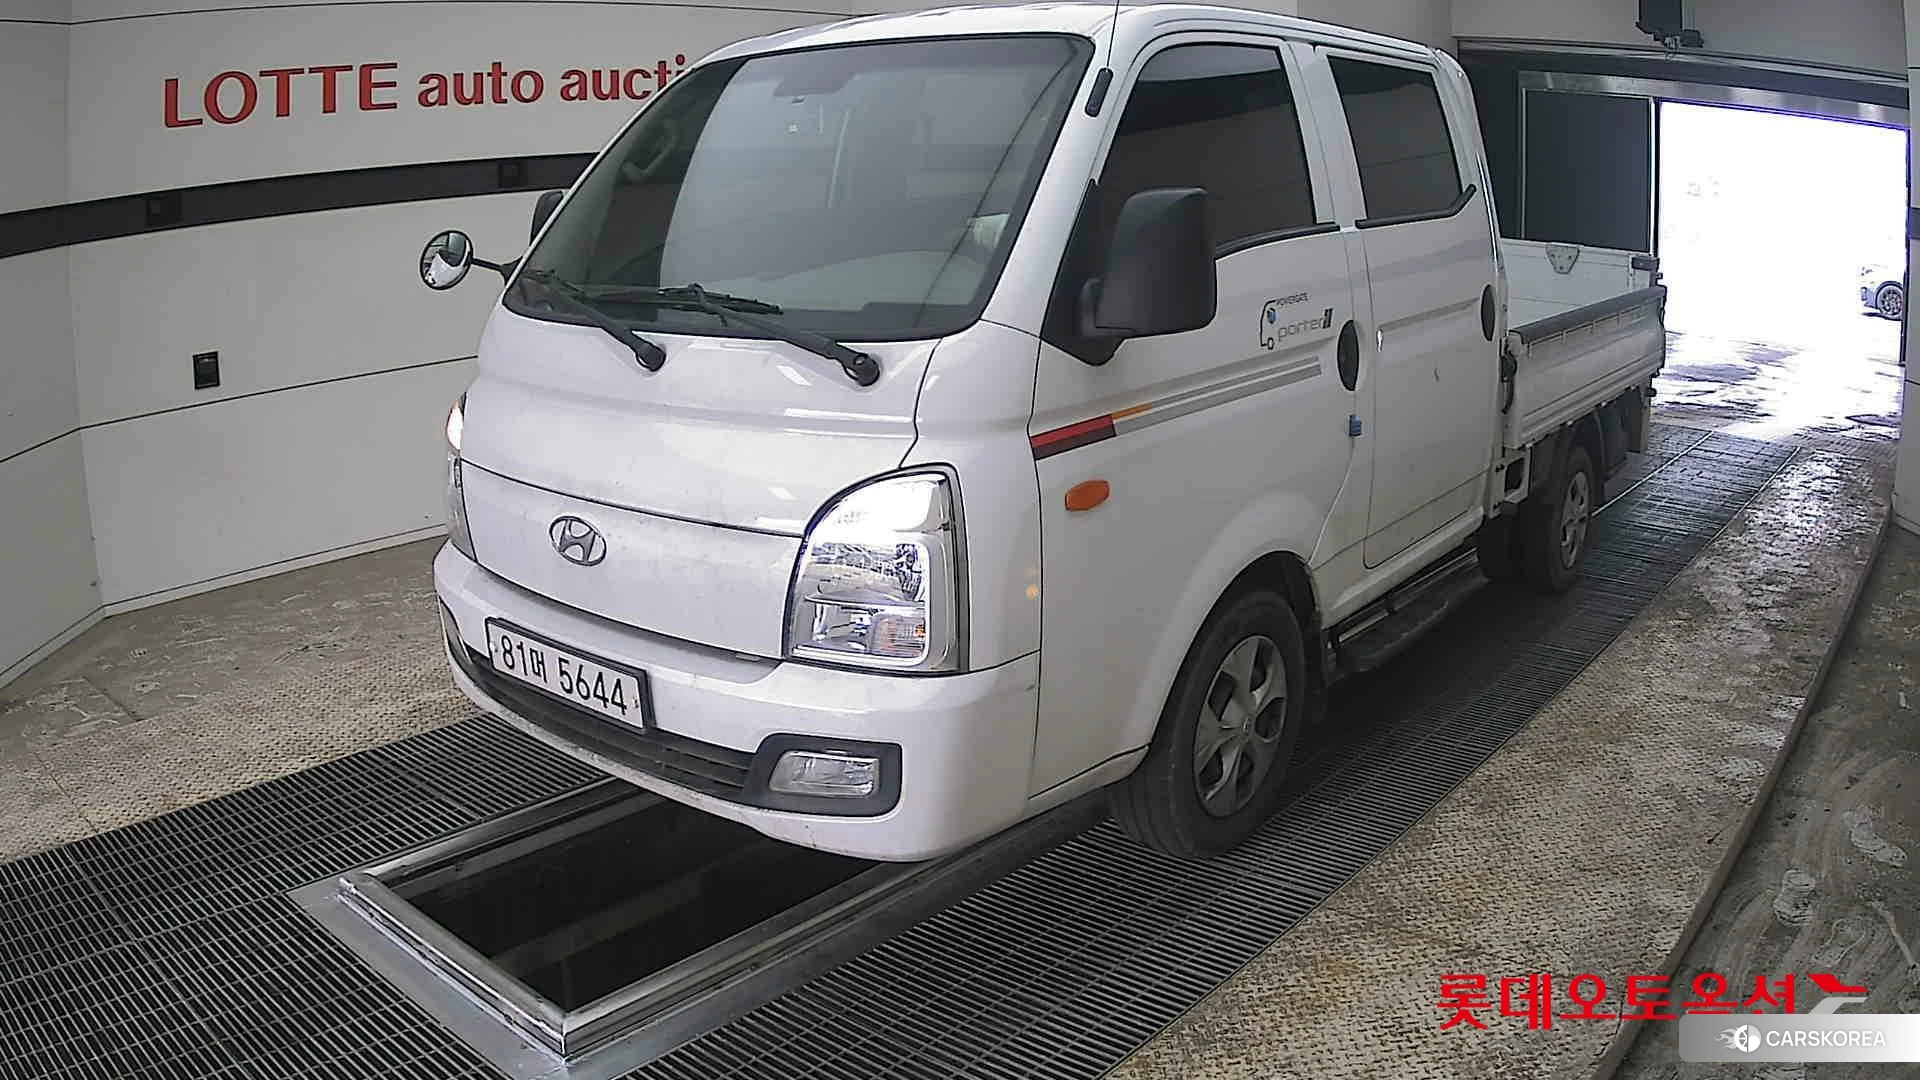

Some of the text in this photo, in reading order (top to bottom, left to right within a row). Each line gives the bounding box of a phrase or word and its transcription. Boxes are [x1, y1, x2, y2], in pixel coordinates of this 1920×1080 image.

[163, 62, 398, 128] LOTTE
[417, 61, 544, 106] auto
[500, 634, 628, 716] 81머 5644
